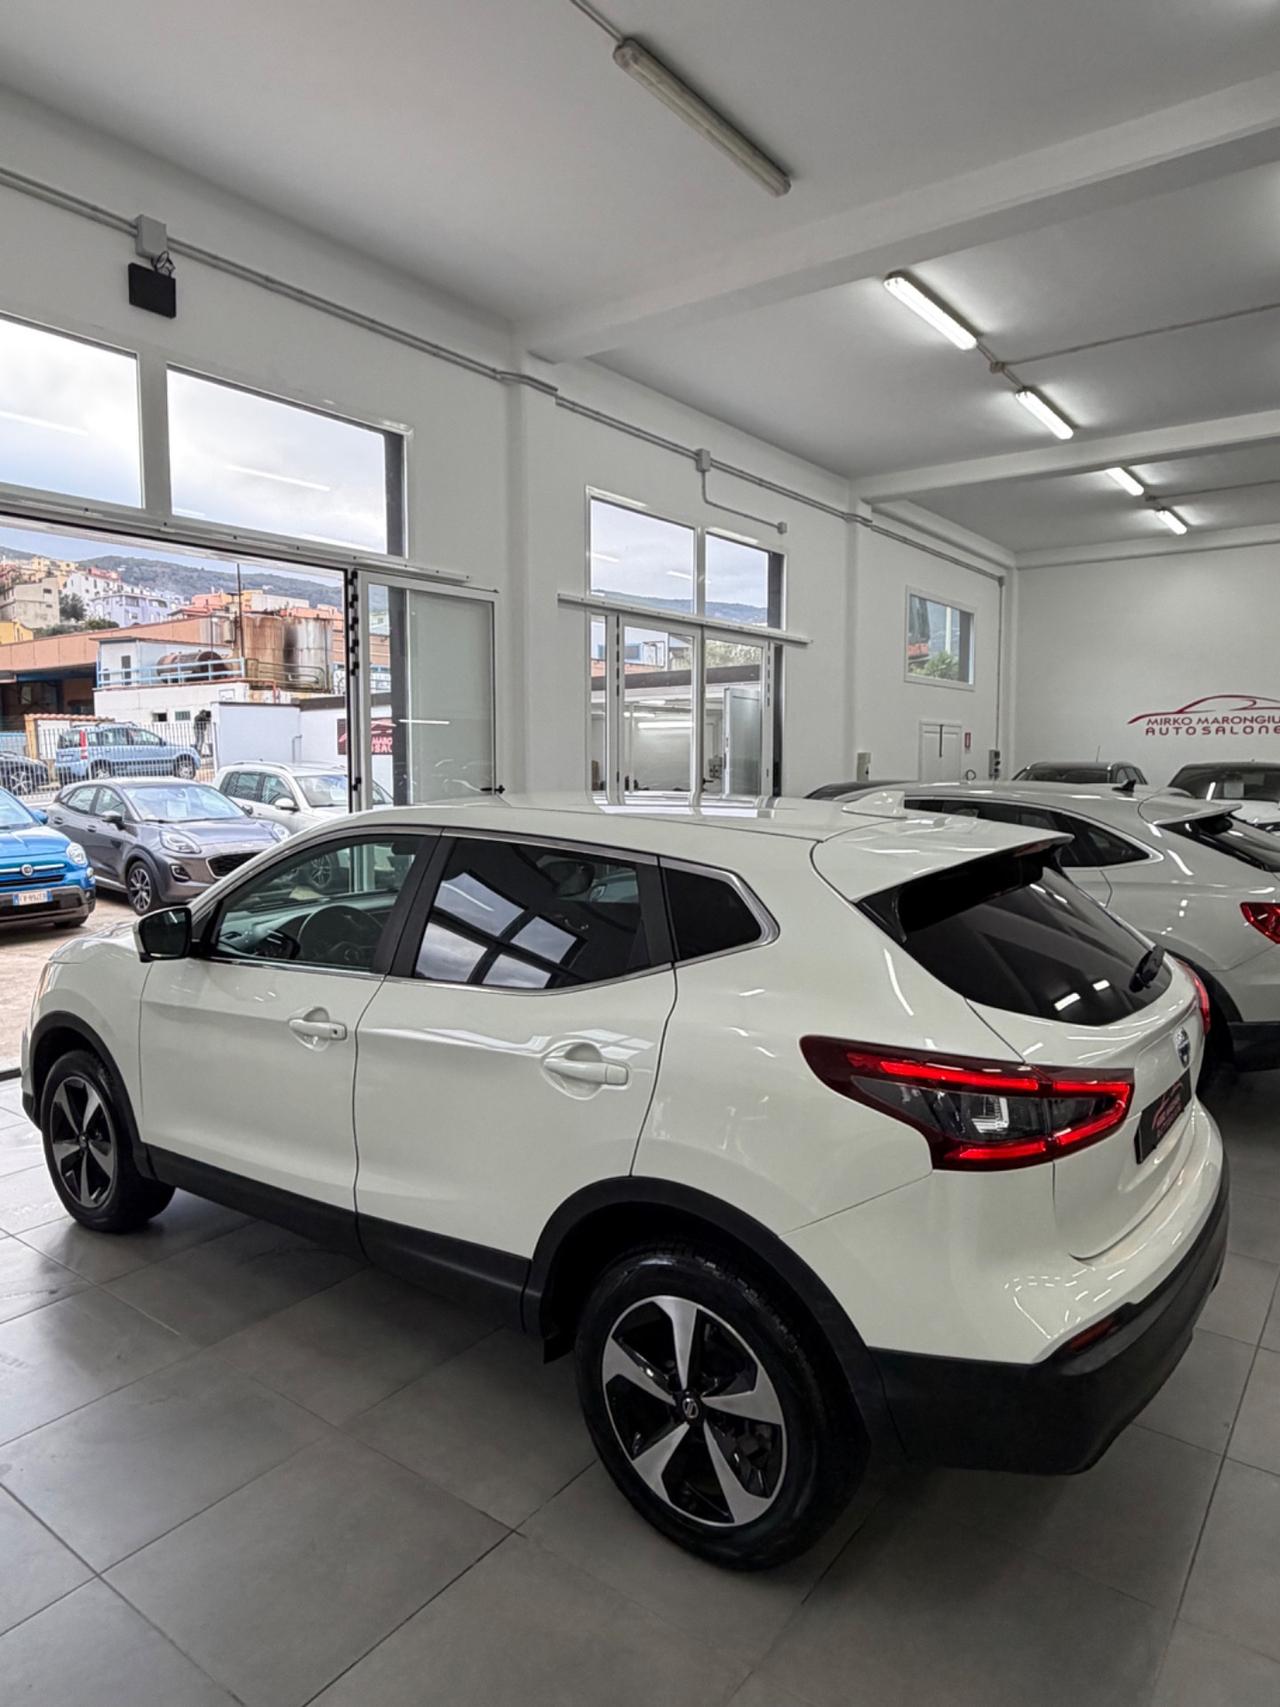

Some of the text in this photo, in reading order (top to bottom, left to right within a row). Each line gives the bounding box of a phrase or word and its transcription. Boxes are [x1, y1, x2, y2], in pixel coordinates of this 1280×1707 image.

[1147, 715, 1280, 726] MIRKO MARONGIU
[1146, 725, 1280, 736] AUTOSALONE
